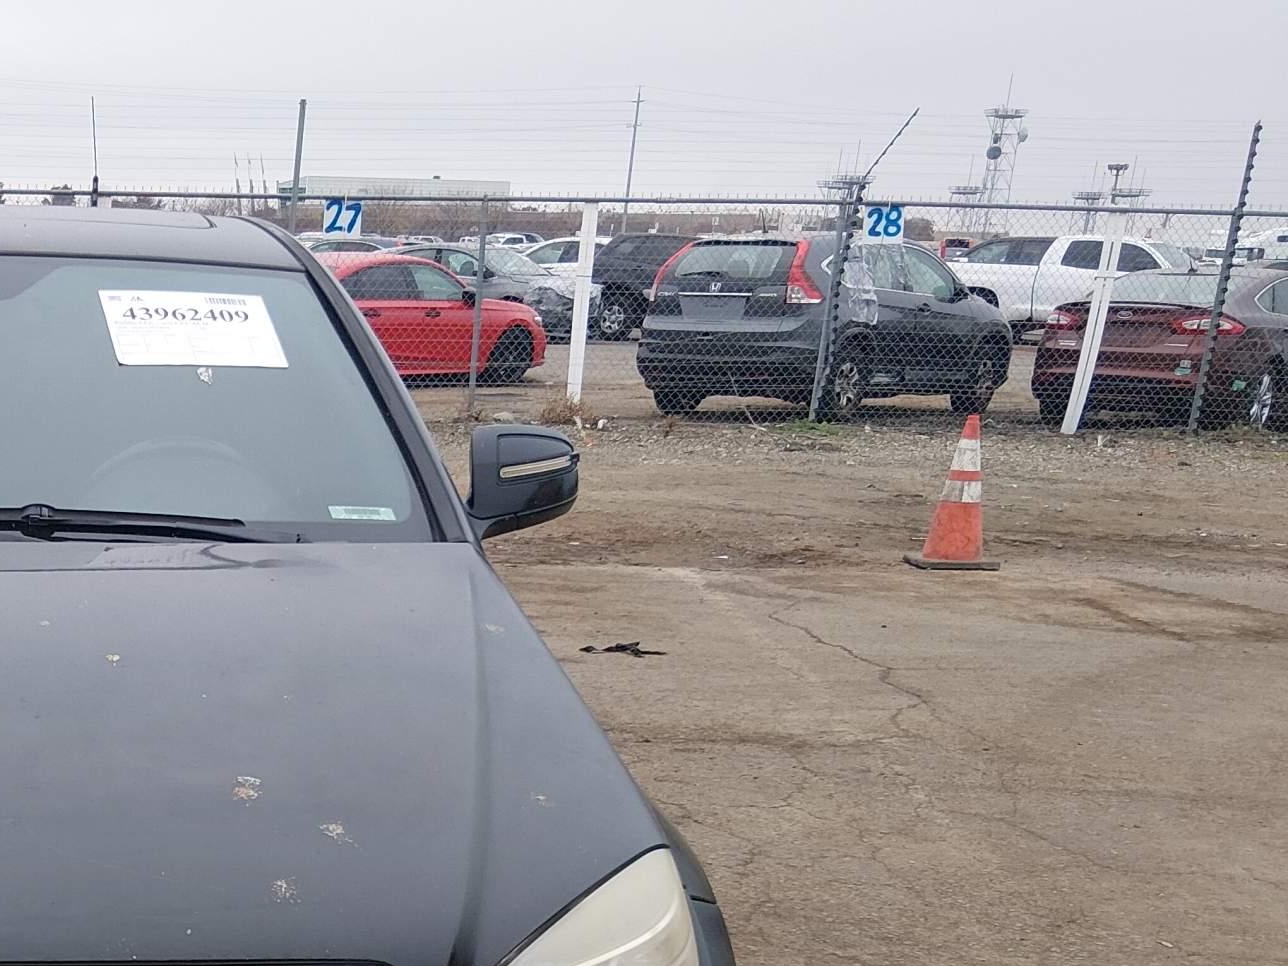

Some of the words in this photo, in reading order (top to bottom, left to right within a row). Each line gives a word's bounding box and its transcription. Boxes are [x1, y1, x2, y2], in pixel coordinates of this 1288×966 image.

[324, 199, 362, 234] 27
[867, 204, 903, 237] 28
[121, 306, 250, 323] 43962409
